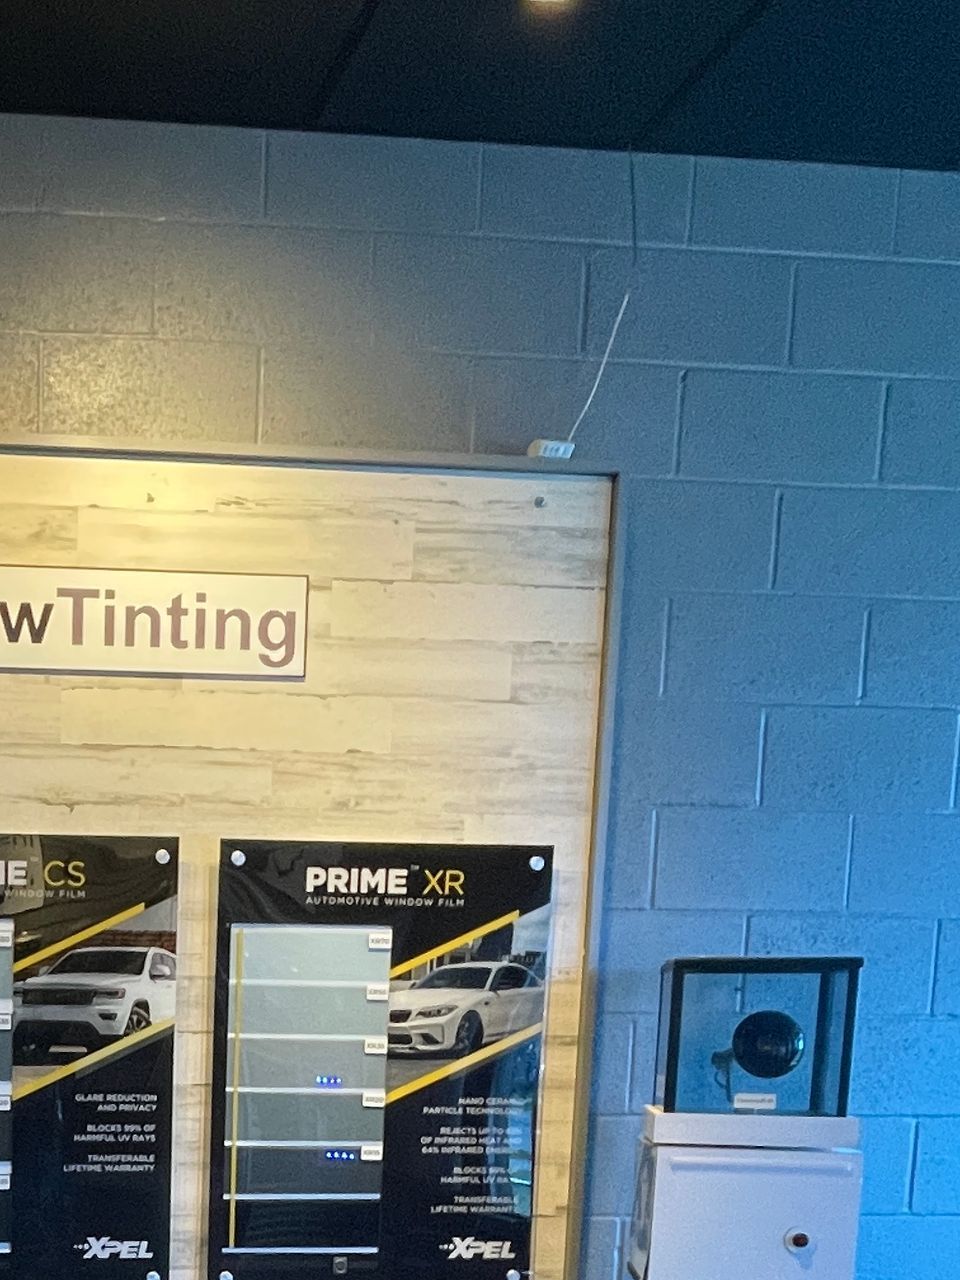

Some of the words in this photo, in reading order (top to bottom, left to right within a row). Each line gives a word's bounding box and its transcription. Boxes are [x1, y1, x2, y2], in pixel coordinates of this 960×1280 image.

[44, 860, 87, 887] CS
[305, 866, 408, 895] PRIME
[422, 869, 465, 896] XR
[5, 888, 54, 898] WINDOW
[59, 889, 86, 899] FILM
[305, 896, 379, 906] AUTOMOTIVE
[384, 897, 433, 907] WINDOW
[438, 898, 465, 907] FILM
[75, 1093, 104, 1102] GLARE
[106, 1093, 158, 1102] REDUCTION
[97, 1103, 117, 1111] AND
[118, 1103, 157, 1111] PRIVACY
[423, 1106, 463, 1115] PARTICLE
[132, 1134, 156, 1142] RAYS
[88, 1154, 155, 1162] TRANSFERABLE
[104, 1164, 156, 1172] WARRANTY
[82, 1236, 154, 1259] XPEL
[447, 1236, 516, 1259] XPEL
